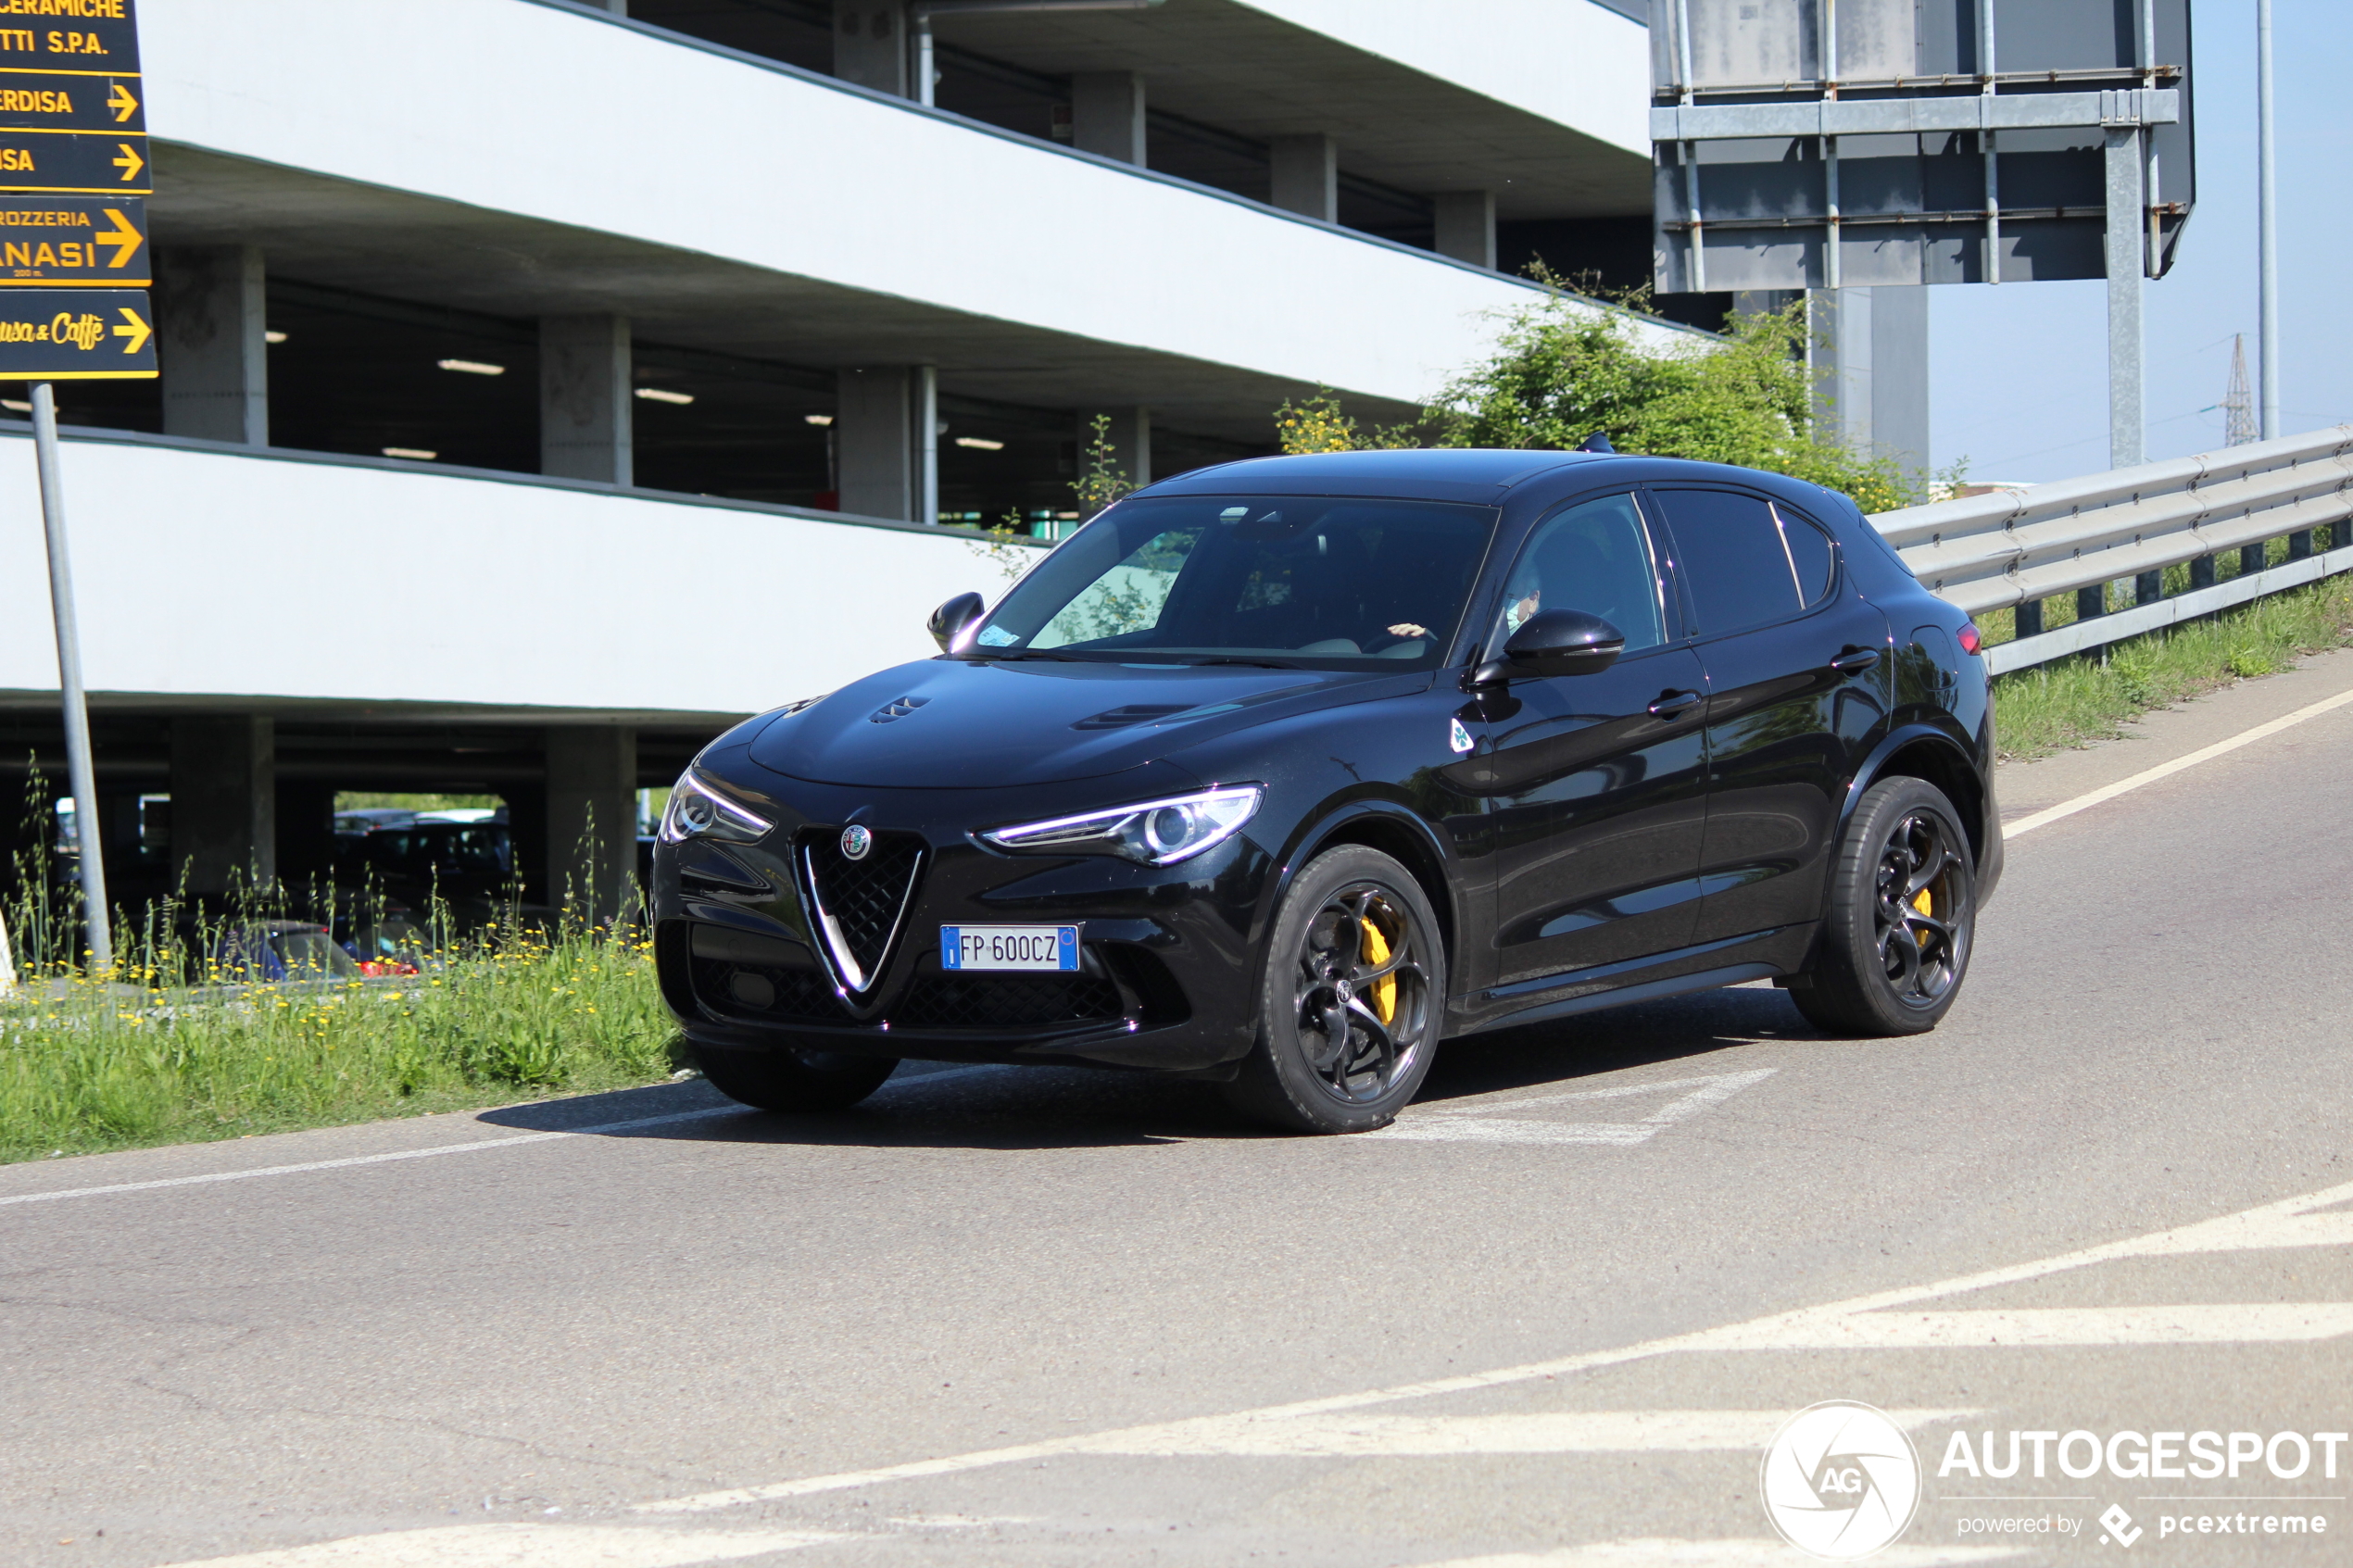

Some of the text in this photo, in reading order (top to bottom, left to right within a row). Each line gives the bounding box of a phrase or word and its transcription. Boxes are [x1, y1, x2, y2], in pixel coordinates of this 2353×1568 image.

[47, 31, 109, 54] S.P.A.
[0, 242, 95, 268] NASI
[36, 324, 50, 341] &
[51, 312, 105, 351] Caffè
